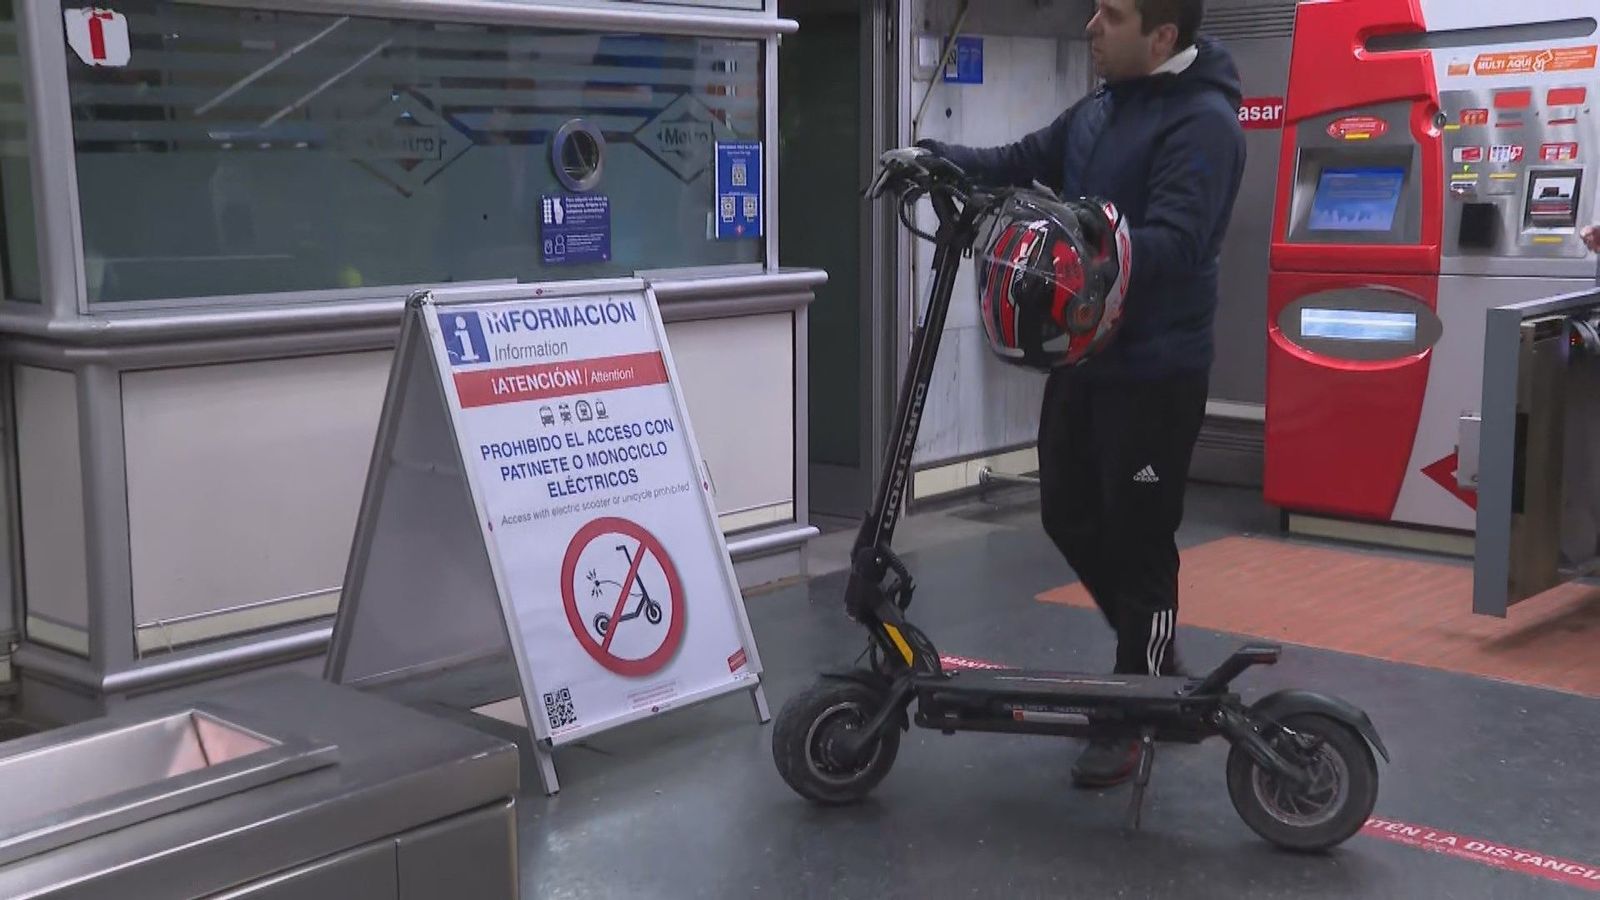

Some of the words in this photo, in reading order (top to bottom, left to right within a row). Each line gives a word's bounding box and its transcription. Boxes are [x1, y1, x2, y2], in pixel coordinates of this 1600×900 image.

[486, 297, 637, 334] INFORMACIÓN
[494, 340, 568, 362] Information
[491, 366, 583, 395] ¡ATENCIÓN!
[590, 366, 635, 384] Attention!
[480, 434, 562, 461] PROHIBIDO
[566, 432, 585, 449] EL
[587, 422, 642, 445] ACCESO
[645, 418, 675, 436] CON
[500, 456, 570, 481] PATINETE
[572, 455, 584, 469] O
[586, 441, 668, 468] MONOCICLO
[547, 468, 639, 498] ELÉCTRICOS
[501, 512, 532, 526] Access
[533, 508, 550, 520] with
[552, 502, 580, 516] electric
[582, 497, 611, 512] scooter
[613, 497, 621, 505] or
[622, 490, 653, 504] unicycle
[654, 483, 690, 499] prohibited
[1424, 831, 1457, 847] LA
